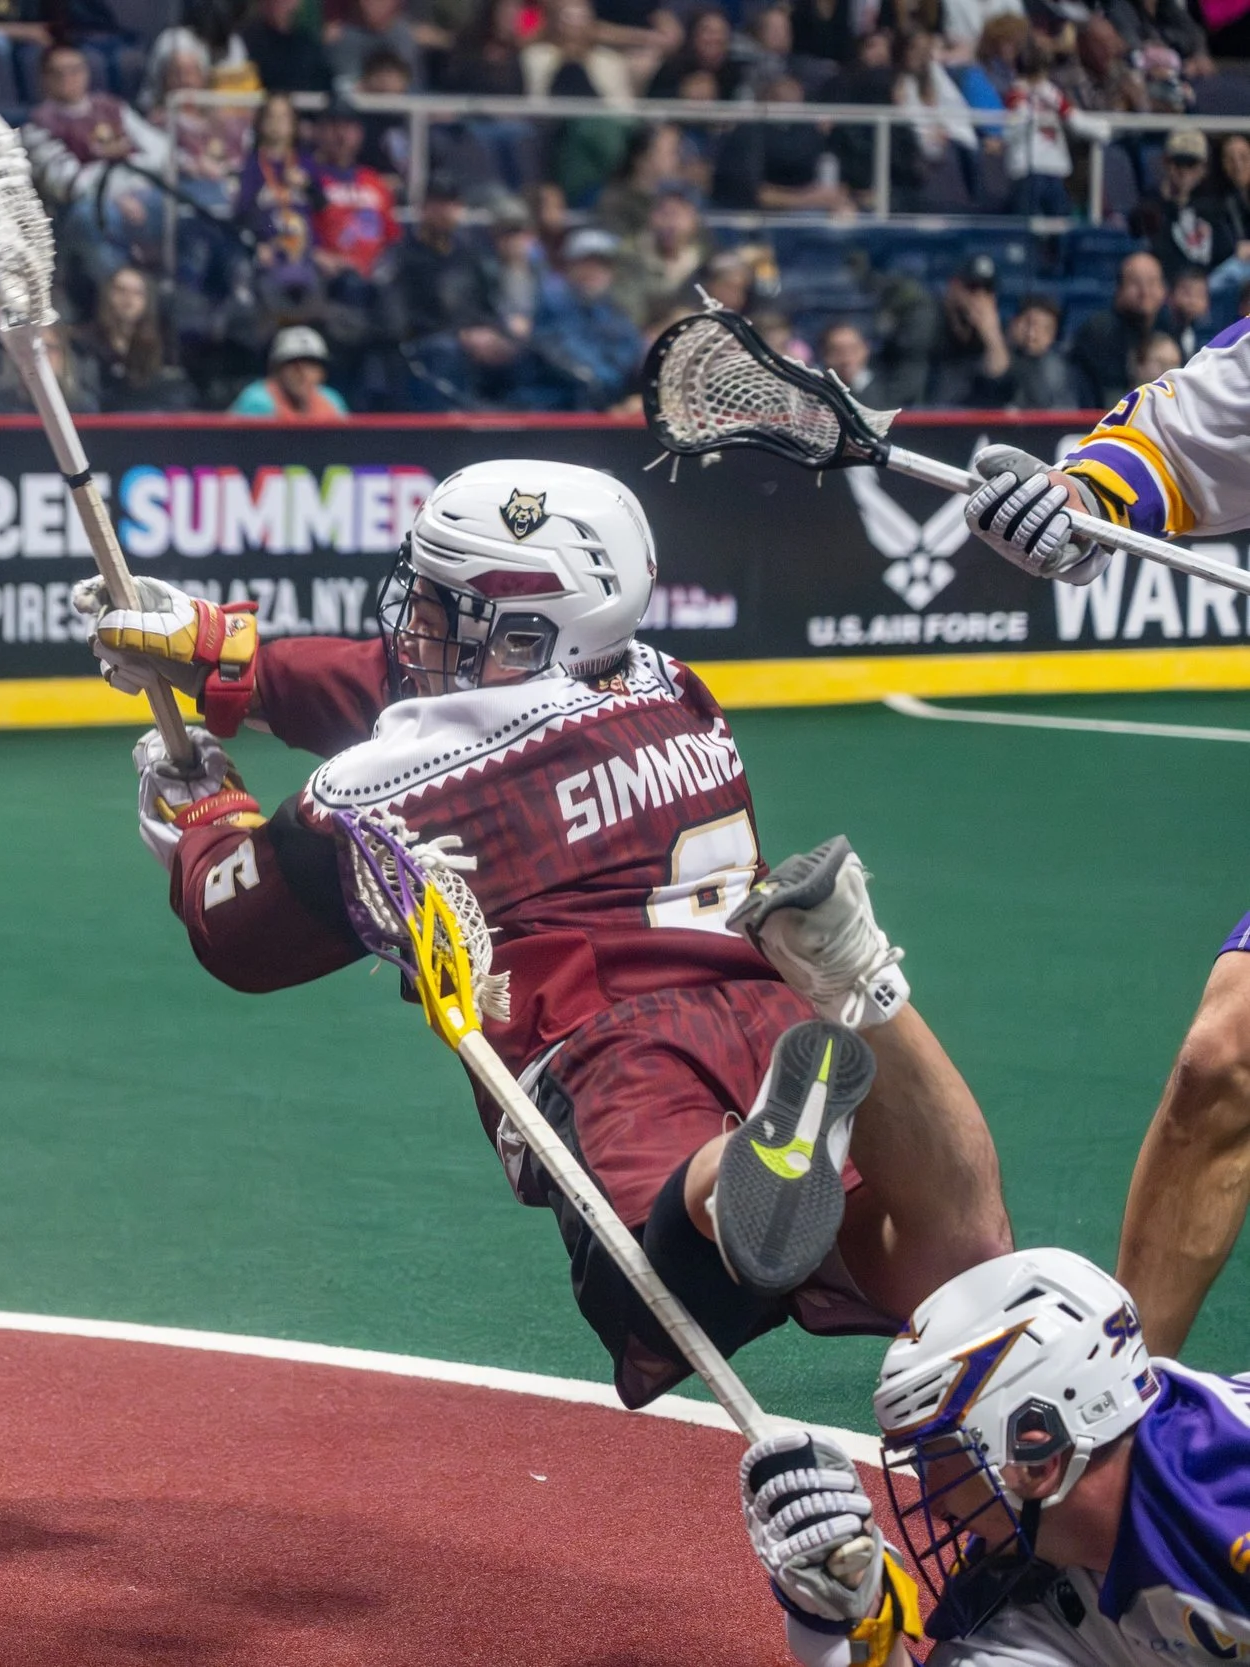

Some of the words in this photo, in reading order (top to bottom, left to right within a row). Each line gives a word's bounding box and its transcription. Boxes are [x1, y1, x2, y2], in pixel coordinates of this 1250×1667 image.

[119, 464, 438, 558] SUMMER
[923, 611, 1029, 643] FORCE
[555, 716, 744, 845] SIMMONS
